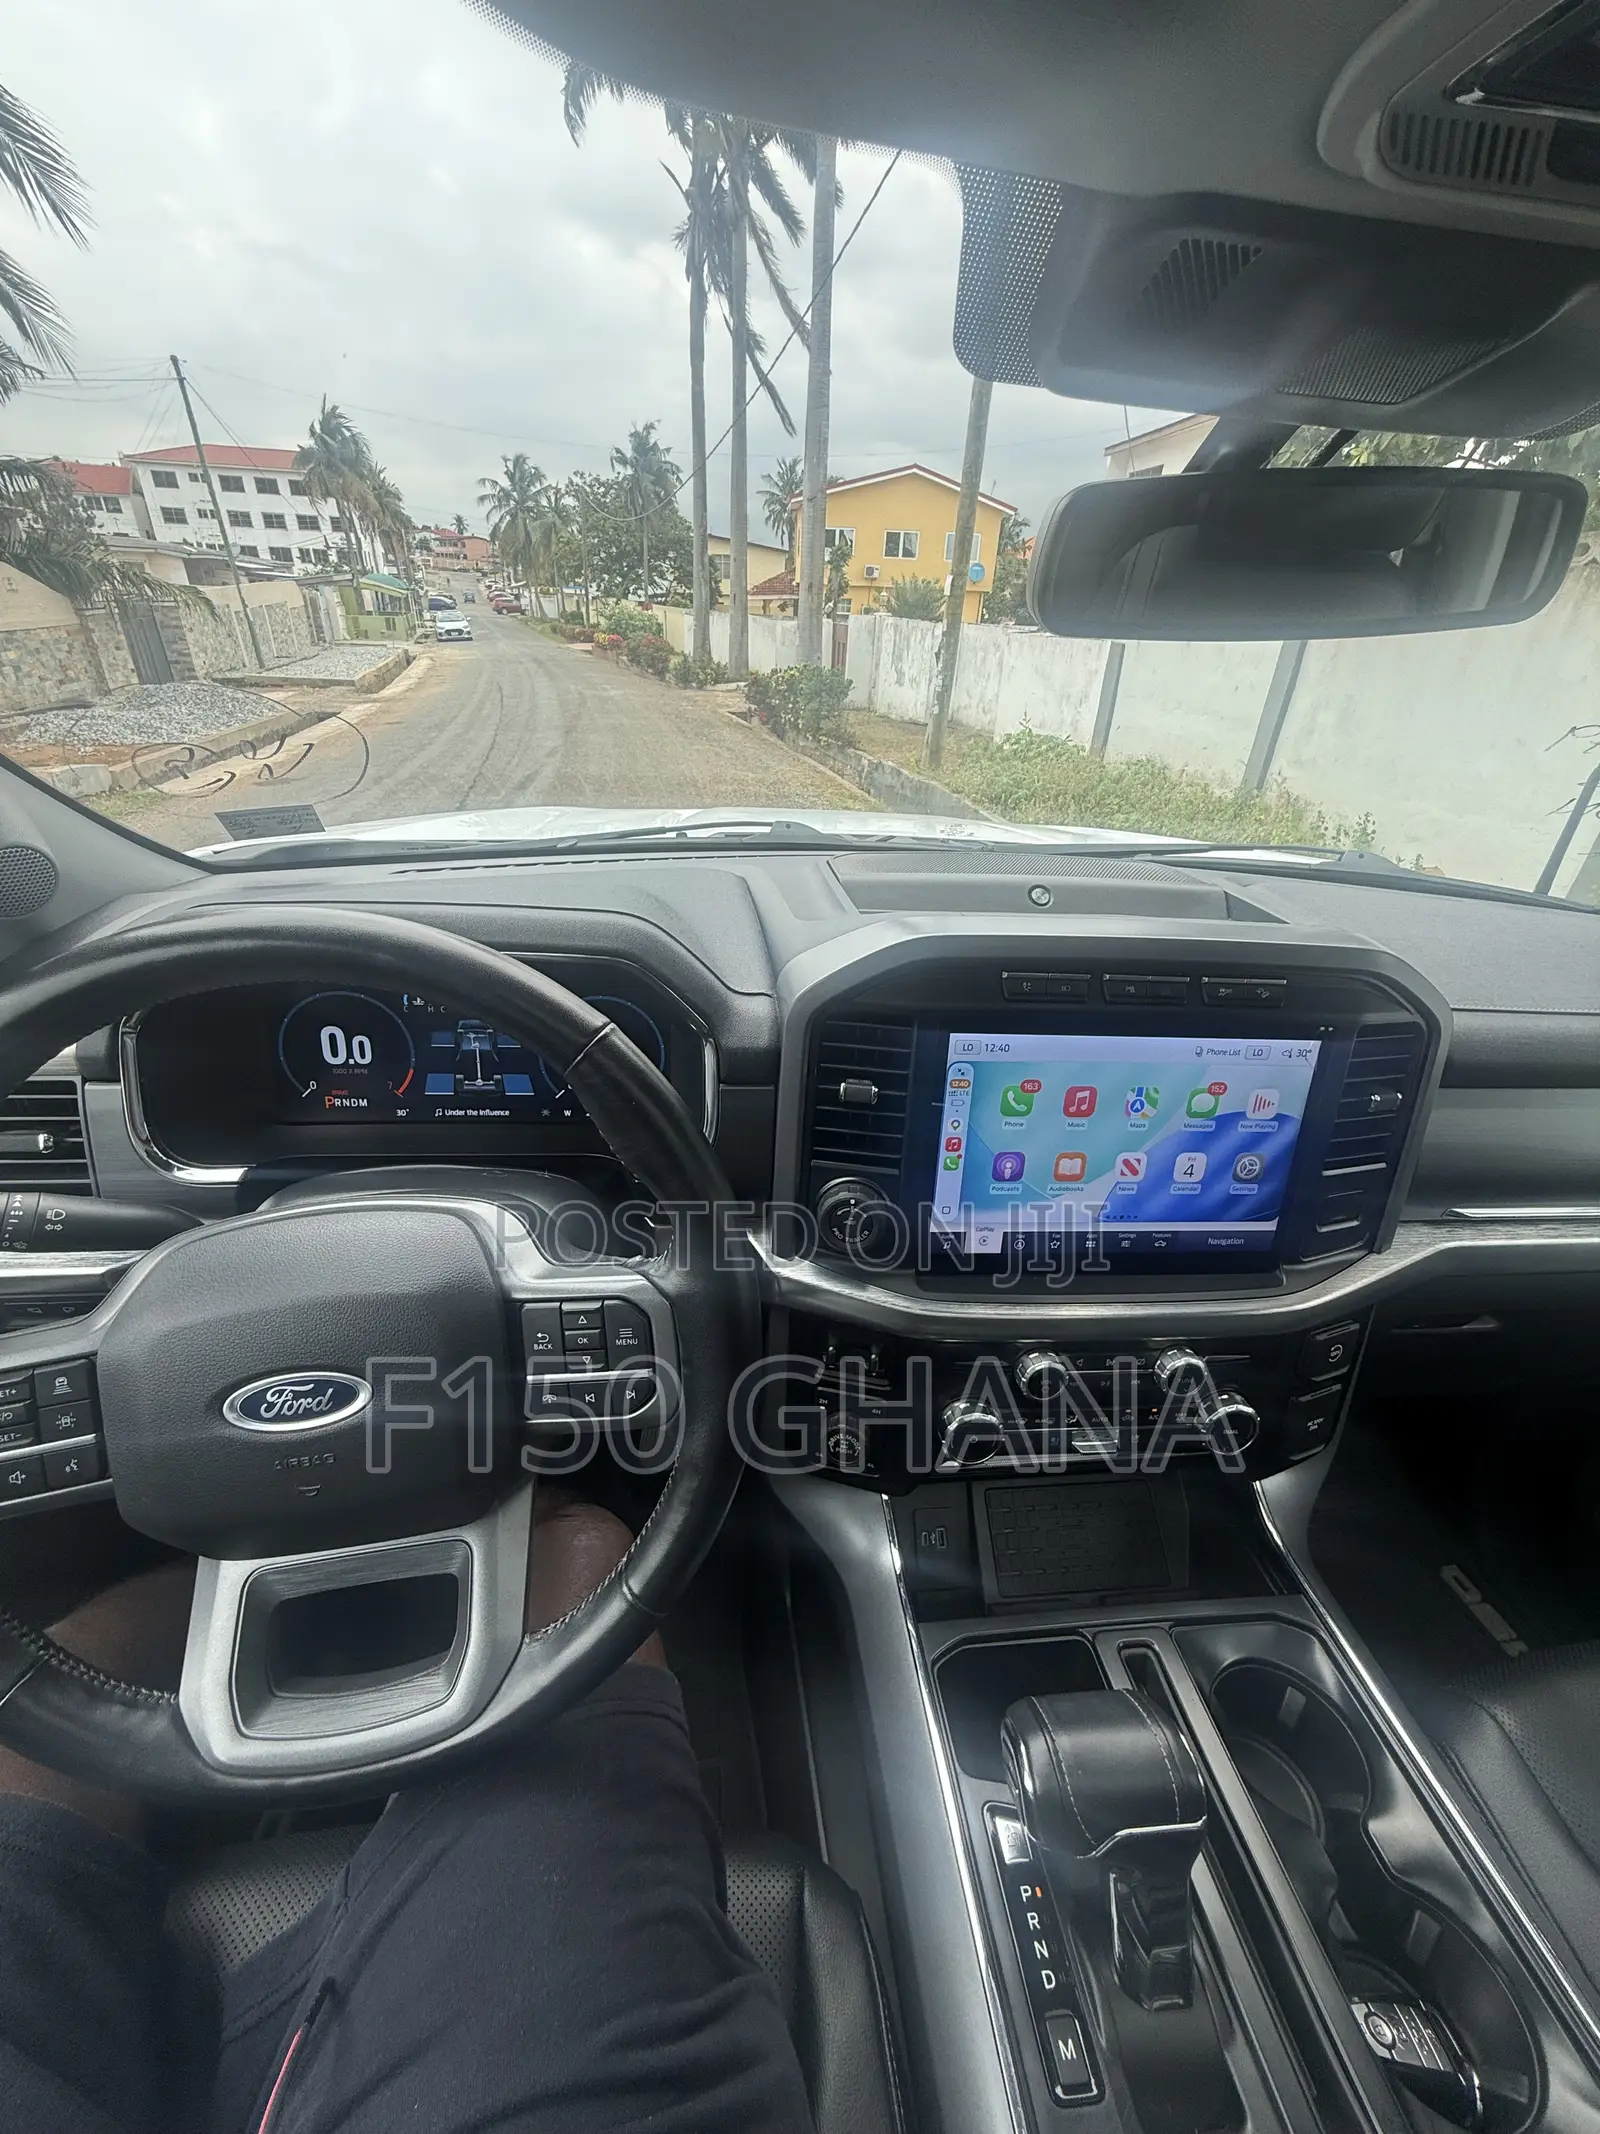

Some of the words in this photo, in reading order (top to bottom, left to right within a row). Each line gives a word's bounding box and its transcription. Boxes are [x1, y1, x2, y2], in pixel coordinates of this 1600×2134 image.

[320, 1025, 372, 1065] 0.0
[962, 1043, 974, 1052] LO
[984, 1043, 1010, 1053] 12:40
[1206, 1048, 1228, 1056] Phone
[1229, 1048, 1241, 1056] List
[309, 1080, 317, 1090] 0
[387, 1081, 393, 1090] 7
[1023, 1082, 1039, 1090] 163
[1210, 1085, 1224, 1093] 152
[1129, 1122, 1146, 1130] Maps
[1183, 1122, 1213, 1131] Messages
[1254, 1123, 1276, 1131] Playing
[1183, 1164, 1195, 1178] 4
[1231, 1185, 1256, 1193] Settings
[832, 1227, 844, 1240] PRO
[845, 1230, 870, 1243] TRAILER
[1207, 1237, 1244, 1246] Navigation
[615, 1338, 638, 1346] MENU
[260, 1383, 334, 1419] Ford
[273, 1453, 336, 1471] AIRBAG
[1020, 1885, 1033, 1902] P
[1027, 1912, 1040, 1931] R
[1033, 1940, 1049, 1960] N
[1042, 1970, 1056, 1990] D
[1057, 2038, 1076, 2061] M
